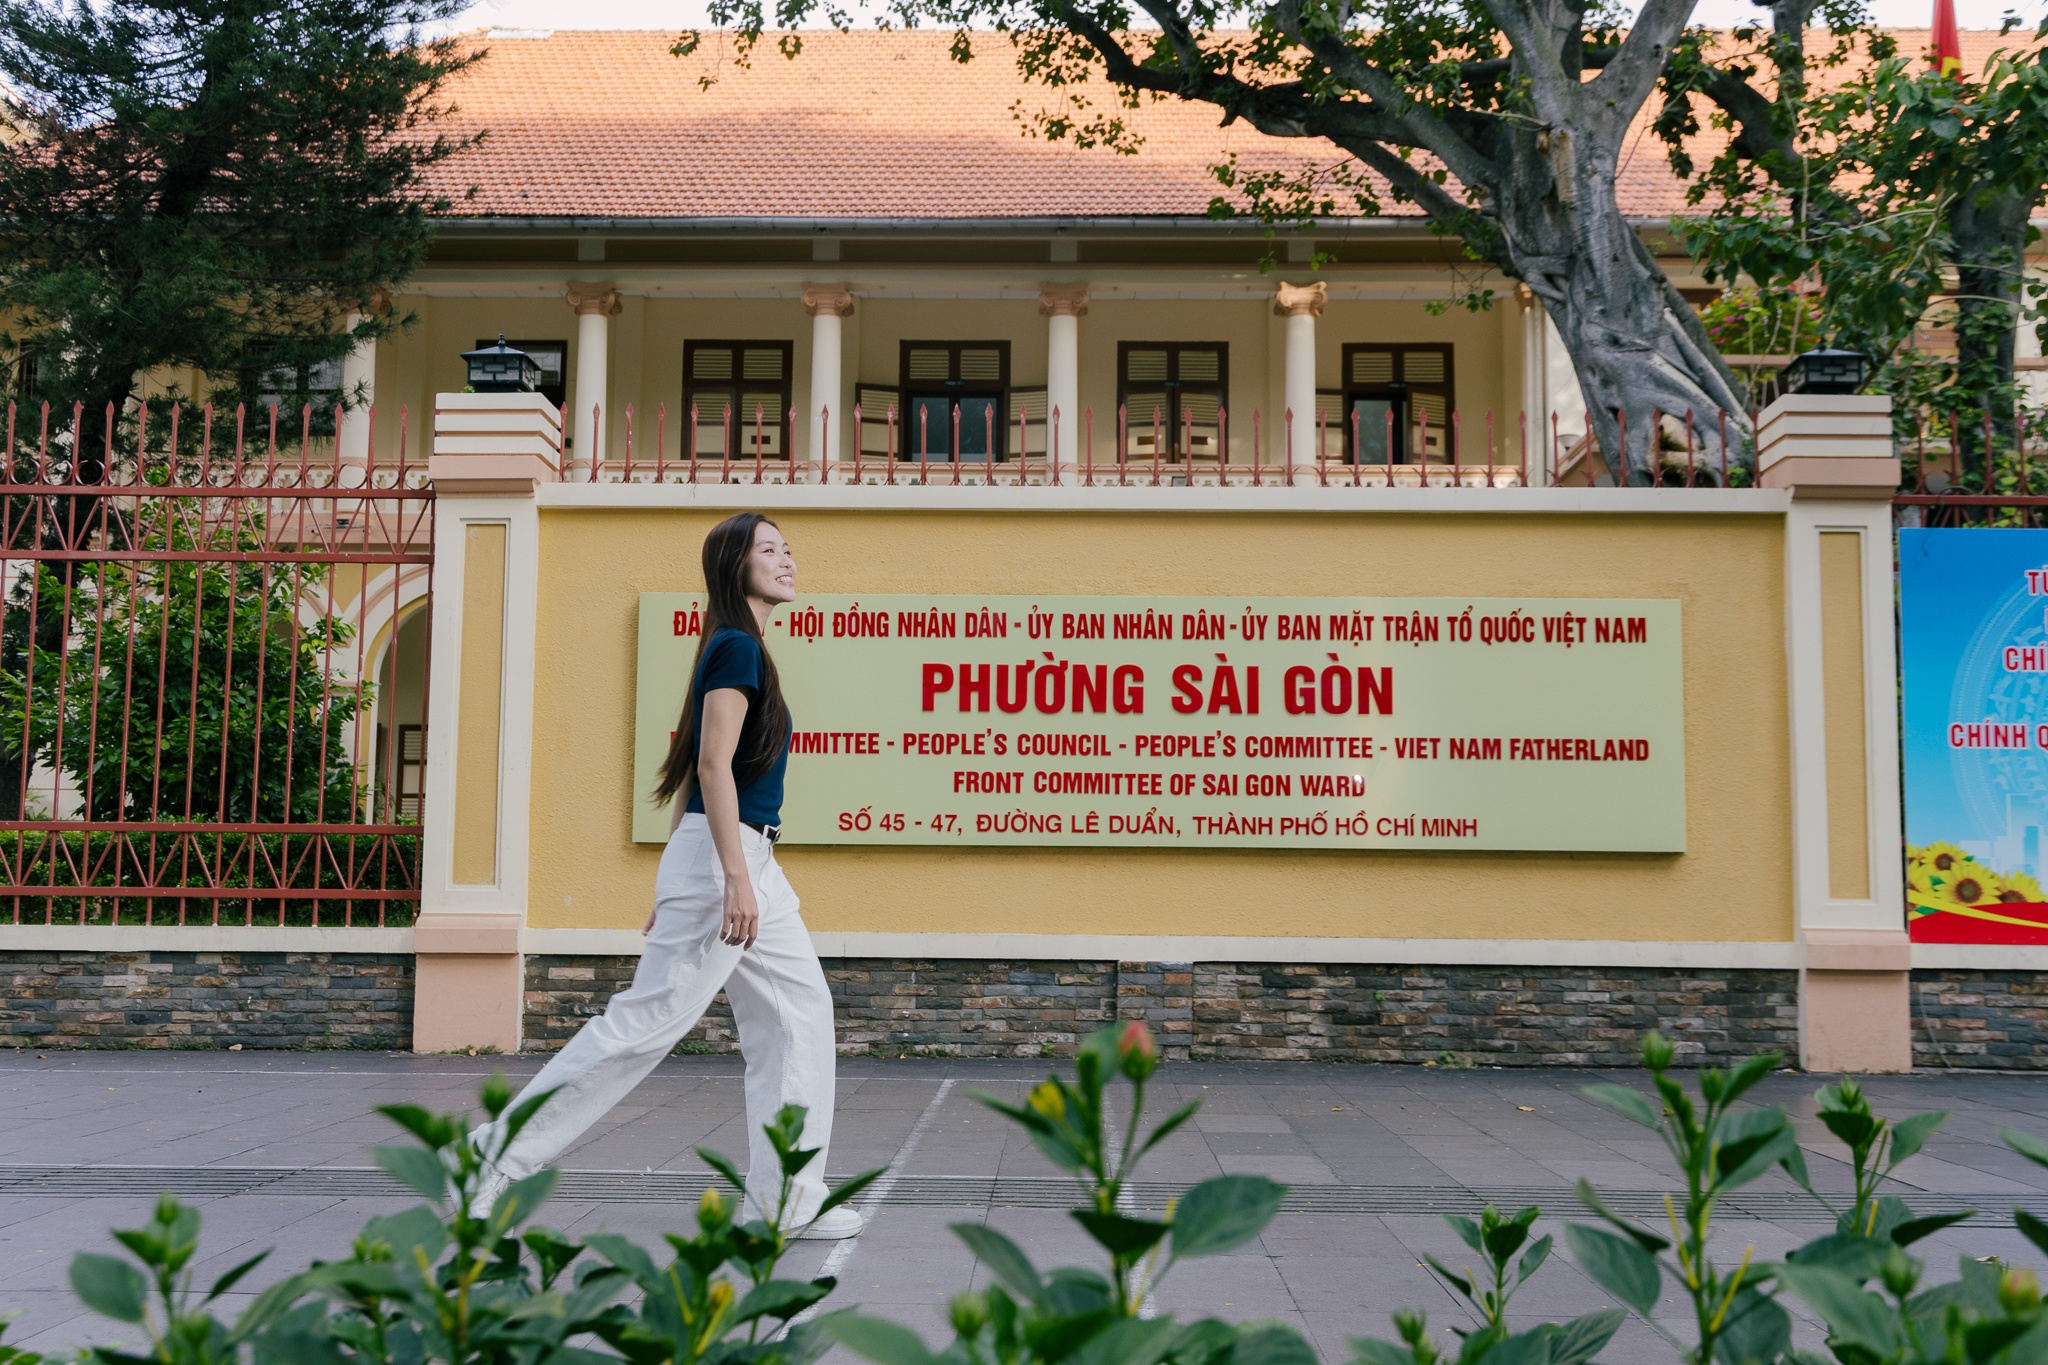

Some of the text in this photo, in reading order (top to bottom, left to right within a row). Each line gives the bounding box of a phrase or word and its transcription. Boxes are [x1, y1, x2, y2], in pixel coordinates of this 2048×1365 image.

[672, 601, 707, 637] ĐẢ
[789, 605, 824, 644] HỘI
[832, 601, 890, 638] ĐỒNG
[897, 606, 956, 639] NHÂN
[964, 606, 1007, 638] DÂN
[1027, 604, 1055, 640] ỦY
[1062, 613, 1105, 640] BAN
[1113, 607, 1173, 640] NHÂN
[1182, 608, 1225, 641] DÂN
[1241, 605, 1269, 641] ỦY
[1277, 614, 1321, 641] BAN
[1329, 610, 1375, 647] MẶT
[1382, 610, 1439, 647] TRẬN
[1446, 605, 1473, 642] TỔ
[1479, 608, 1535, 645] QUỐC
[1542, 611, 1587, 648] VIỆT
[1594, 617, 1647, 643] NAM
[921, 651, 1393, 716] PHƯỜNG SÀI GÒN
[903, 728, 1008, 756] PEOPLE'S
[1017, 733, 1112, 757] COUNCIL
[1135, 730, 1237, 758] PEOPLE'S
[1244, 735, 1374, 759] COMMITTEE
[1394, 737, 1441, 759] VIET
[1449, 737, 1502, 760] NAM
[1509, 737, 1650, 761] FATHERLAND
[1950, 720, 2027, 749] CHÍNH
[953, 771, 1365, 797] FRONT COMMITTEE OF SAI GON WARD
[838, 805, 872, 832] SỐ
[879, 813, 905, 832] 45
[930, 813, 963, 835] 47,
[975, 808, 1062, 834] ĐƯỜNG
[1071, 810, 1100, 834] LÊ
[1108, 806, 1181, 837] DUẨN,
[1192, 811, 1273, 835] THÀNH
[1280, 808, 1328, 836] PHỐ
[1335, 808, 1369, 836] HỒ
[1376, 813, 1415, 837] CHÍ
[1421, 818, 1478, 837] MINH
